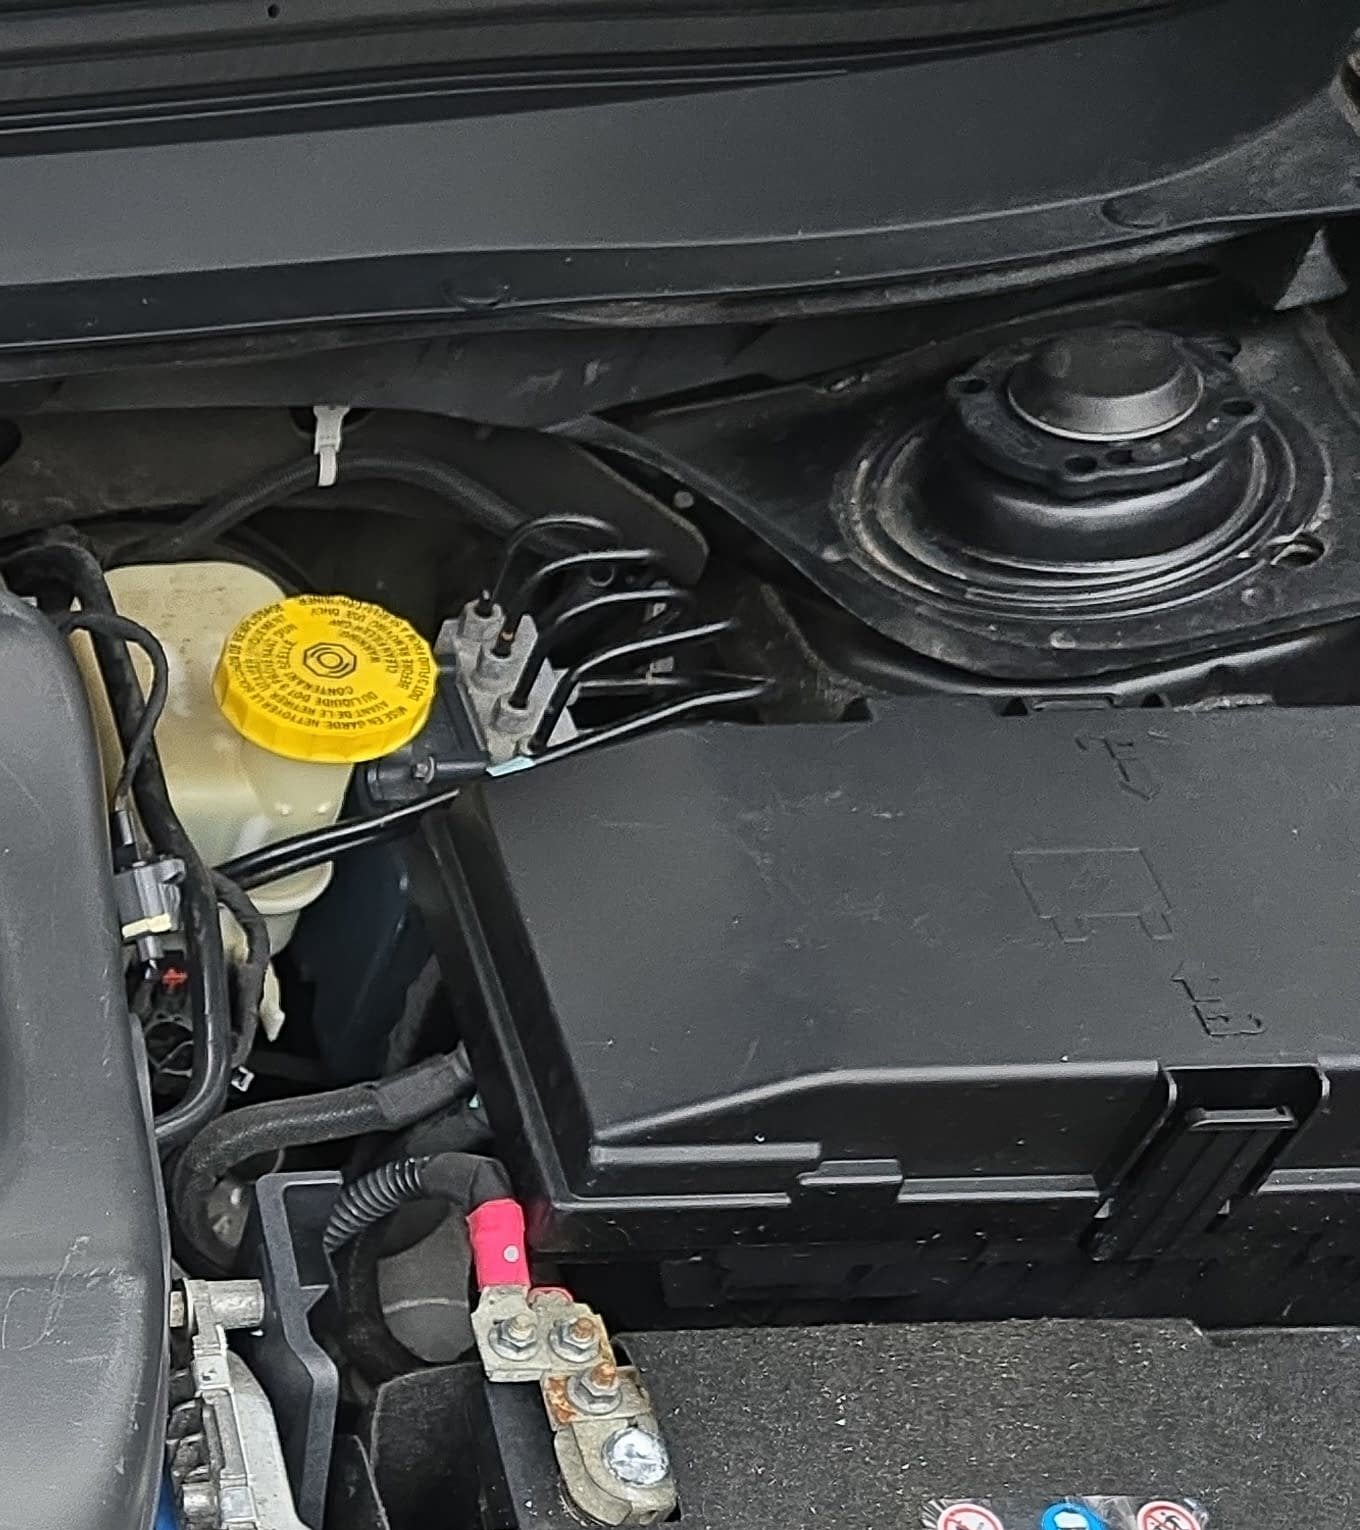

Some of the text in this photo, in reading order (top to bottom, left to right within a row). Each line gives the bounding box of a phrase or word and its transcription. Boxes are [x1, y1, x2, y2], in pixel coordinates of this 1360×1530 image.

[287, 690, 311, 702] DOT
[315, 697, 362, 708] LIQUIDE
[261, 701, 319, 728] NETTOYER
[320, 709, 334, 718] LE
[339, 710, 353, 719] DE
